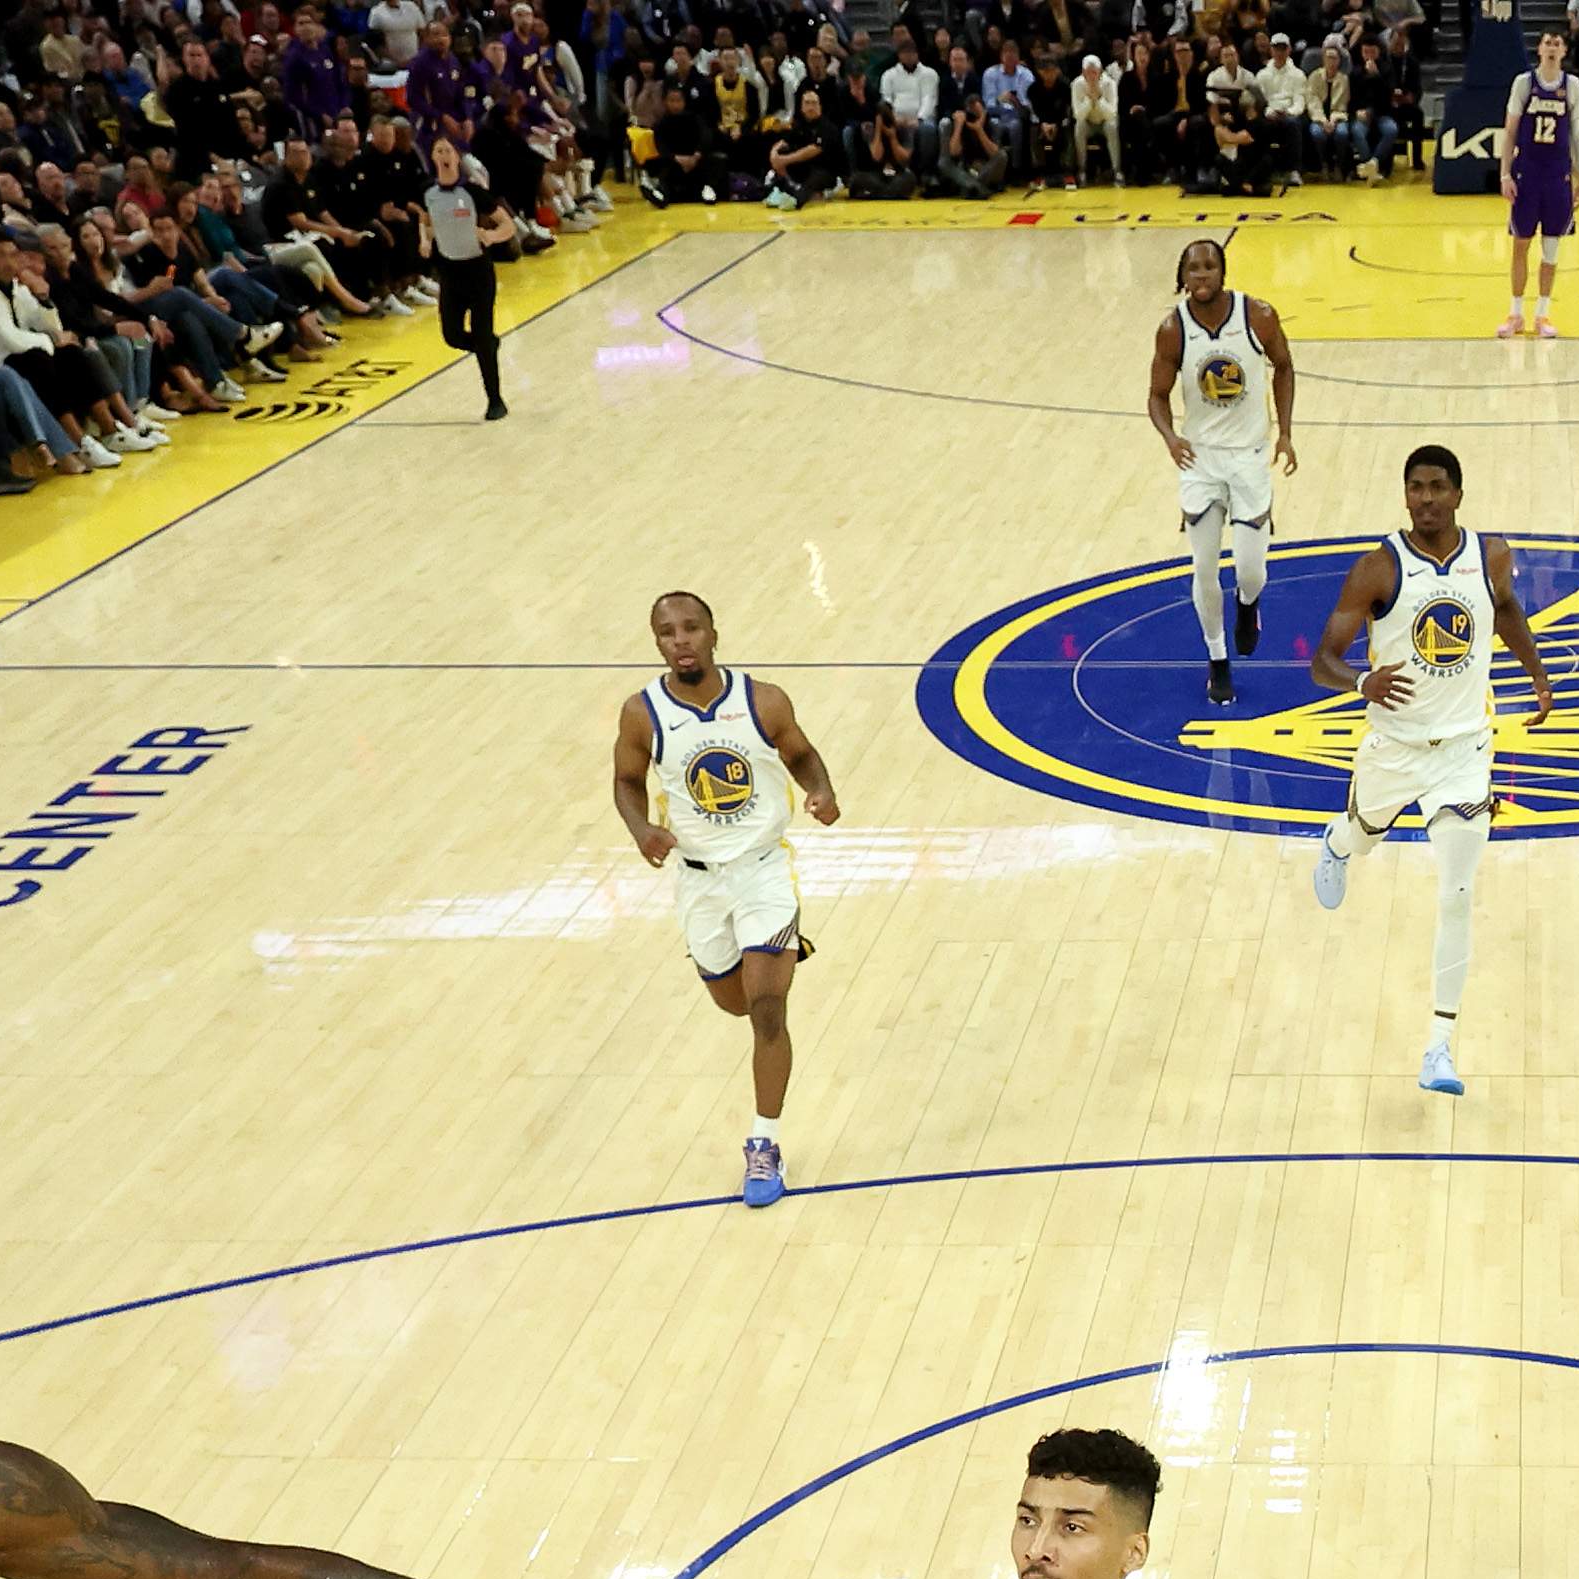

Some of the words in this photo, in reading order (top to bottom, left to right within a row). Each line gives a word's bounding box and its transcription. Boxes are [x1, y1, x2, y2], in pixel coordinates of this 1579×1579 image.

[1534, 116, 1556, 143] 12
[1441, 127, 1519, 159] KI
[1452, 614, 1469, 634] 19
[725, 761, 746, 782] 18
